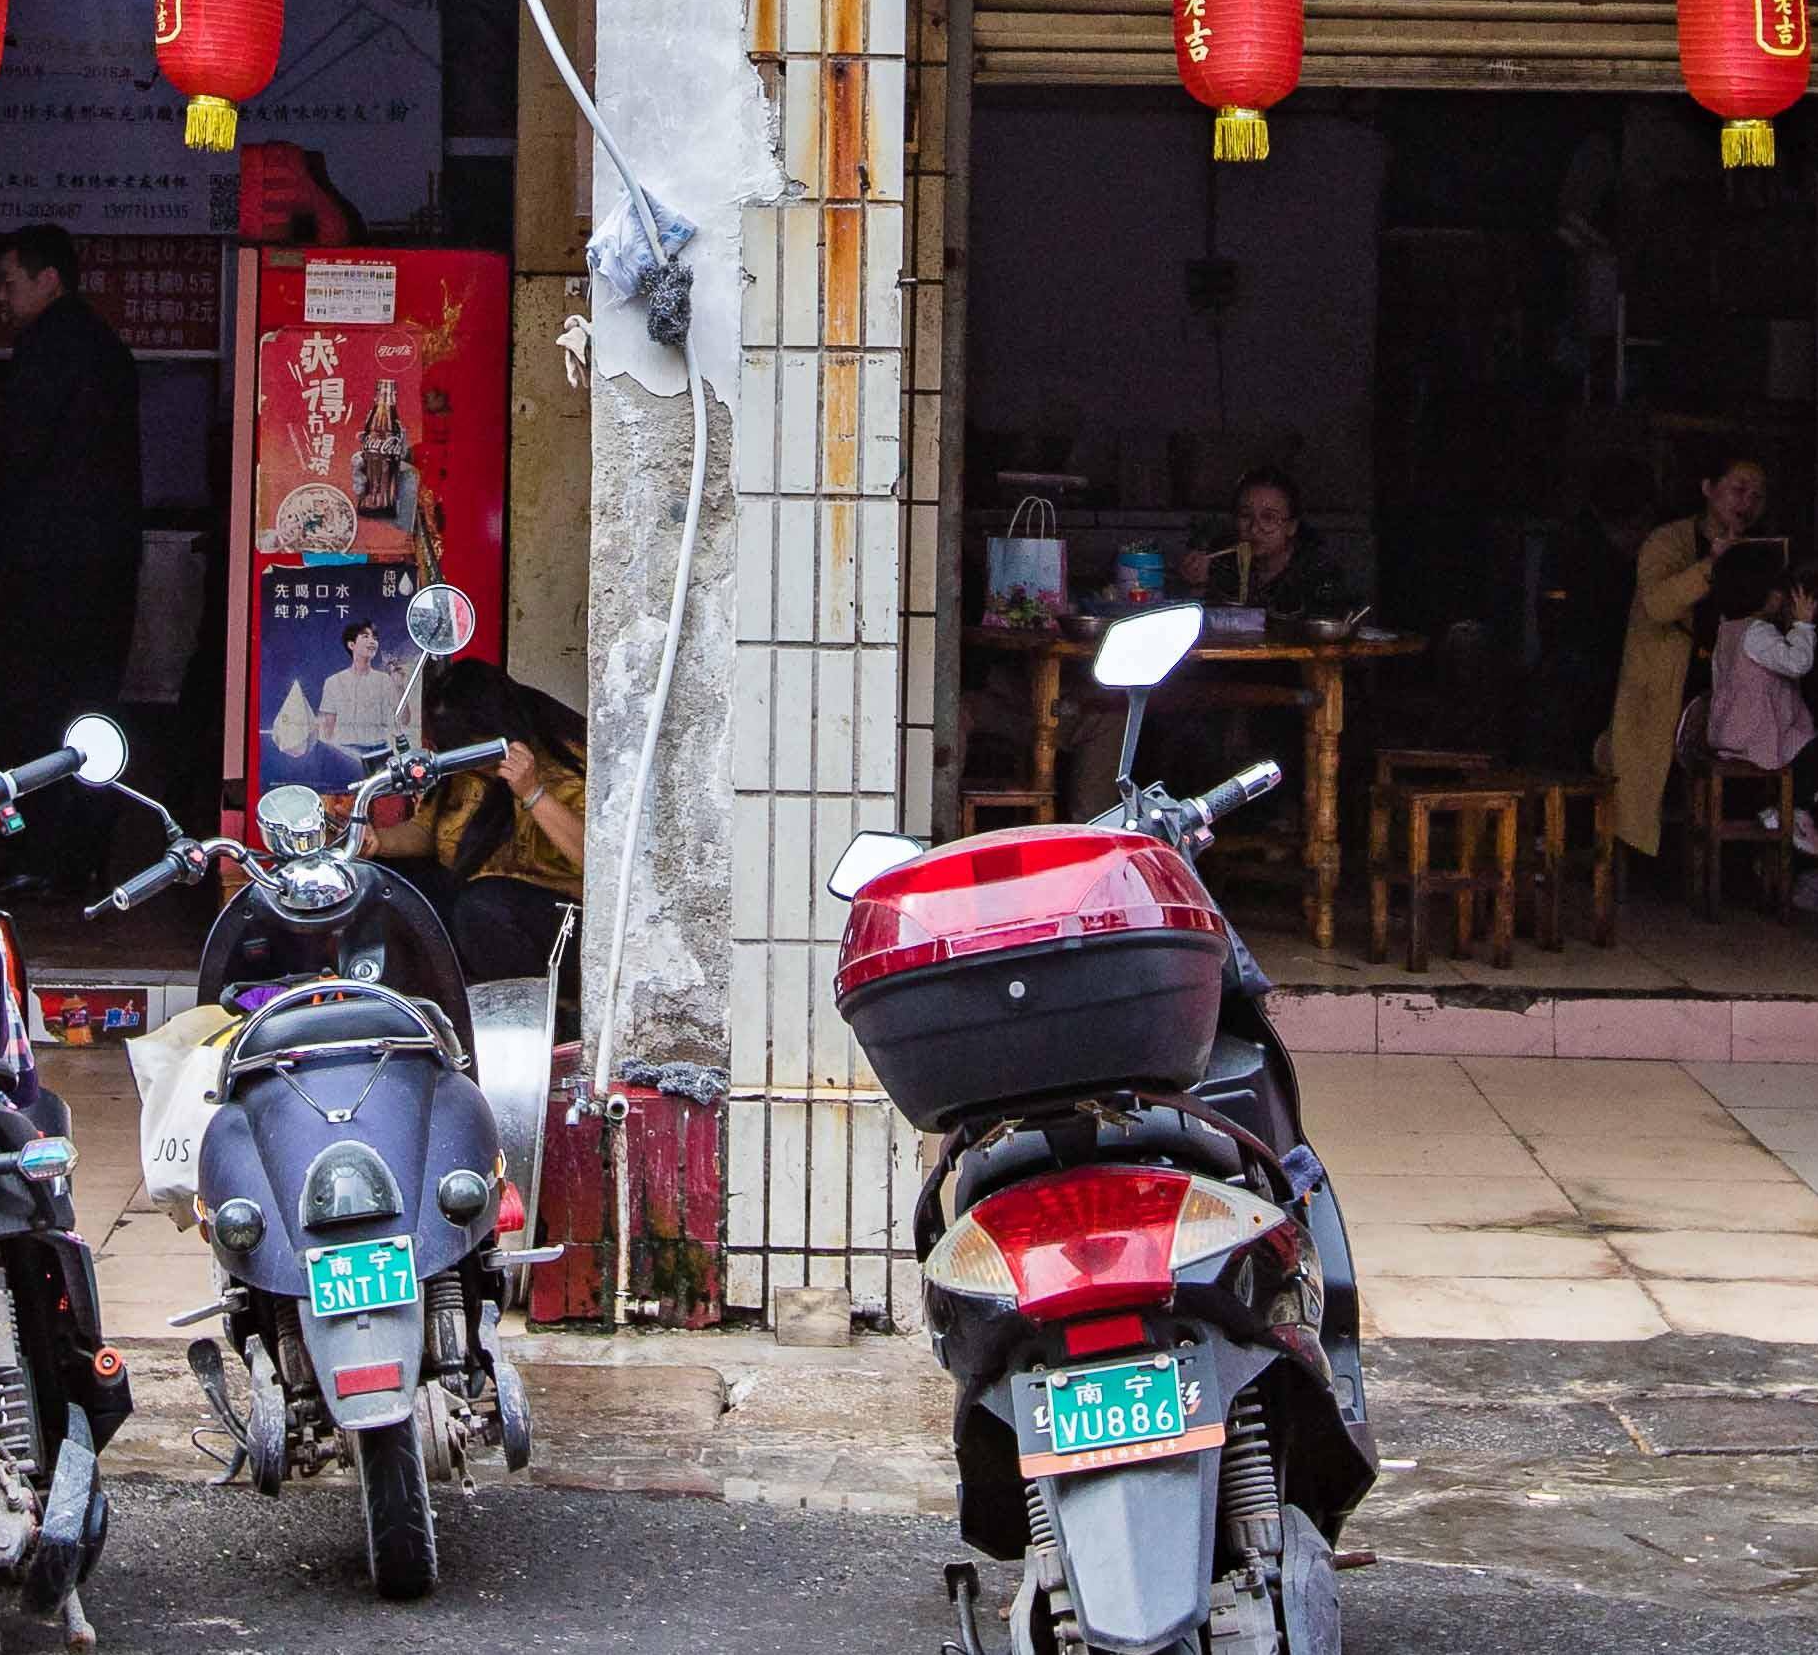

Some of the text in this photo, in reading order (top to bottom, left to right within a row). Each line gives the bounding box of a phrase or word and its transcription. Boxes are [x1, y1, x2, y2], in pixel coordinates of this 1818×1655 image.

[274, 583, 351, 599] 先喝口水
[274, 604, 351, 619] 纯净一下
[327, 1249, 392, 1278] 南宁
[318, 1269, 409, 1311] 3NT17
[1073, 1374, 1154, 1407] 南宁
[1058, 1399, 1175, 1445] VU886
